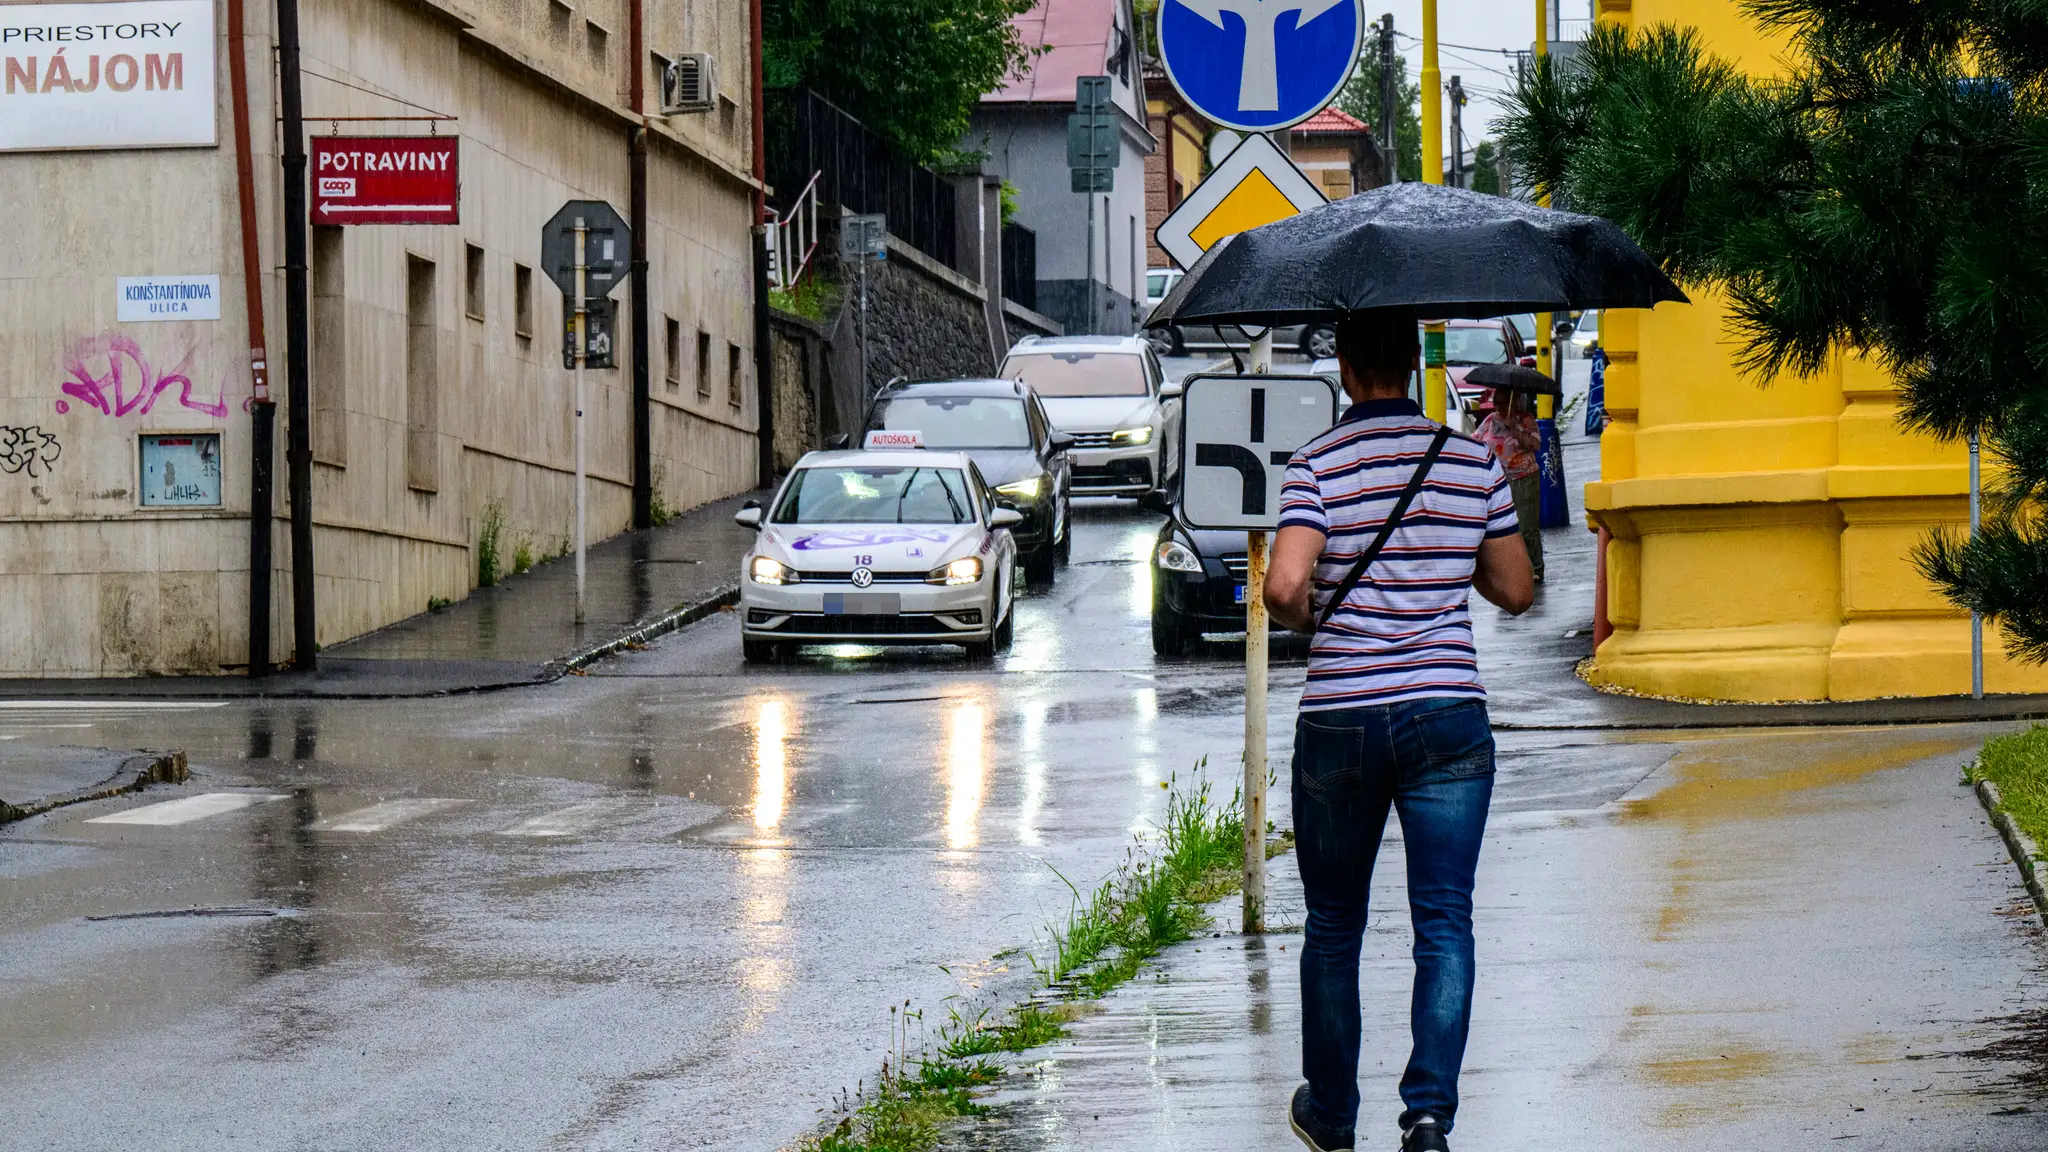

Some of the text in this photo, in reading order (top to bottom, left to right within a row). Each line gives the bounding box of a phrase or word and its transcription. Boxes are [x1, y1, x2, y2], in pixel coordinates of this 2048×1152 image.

[3, 22, 182, 43] PRIESTORY
[5, 47, 184, 94] NÁJOM
[319, 151, 450, 171] POTRAVINY
[126, 281, 212, 301] KONŠTANTÍNOVA
[150, 302, 188, 313] ULICA
[872, 434, 917, 445] AUTOŠKOLA
[854, 555, 873, 566] 18
